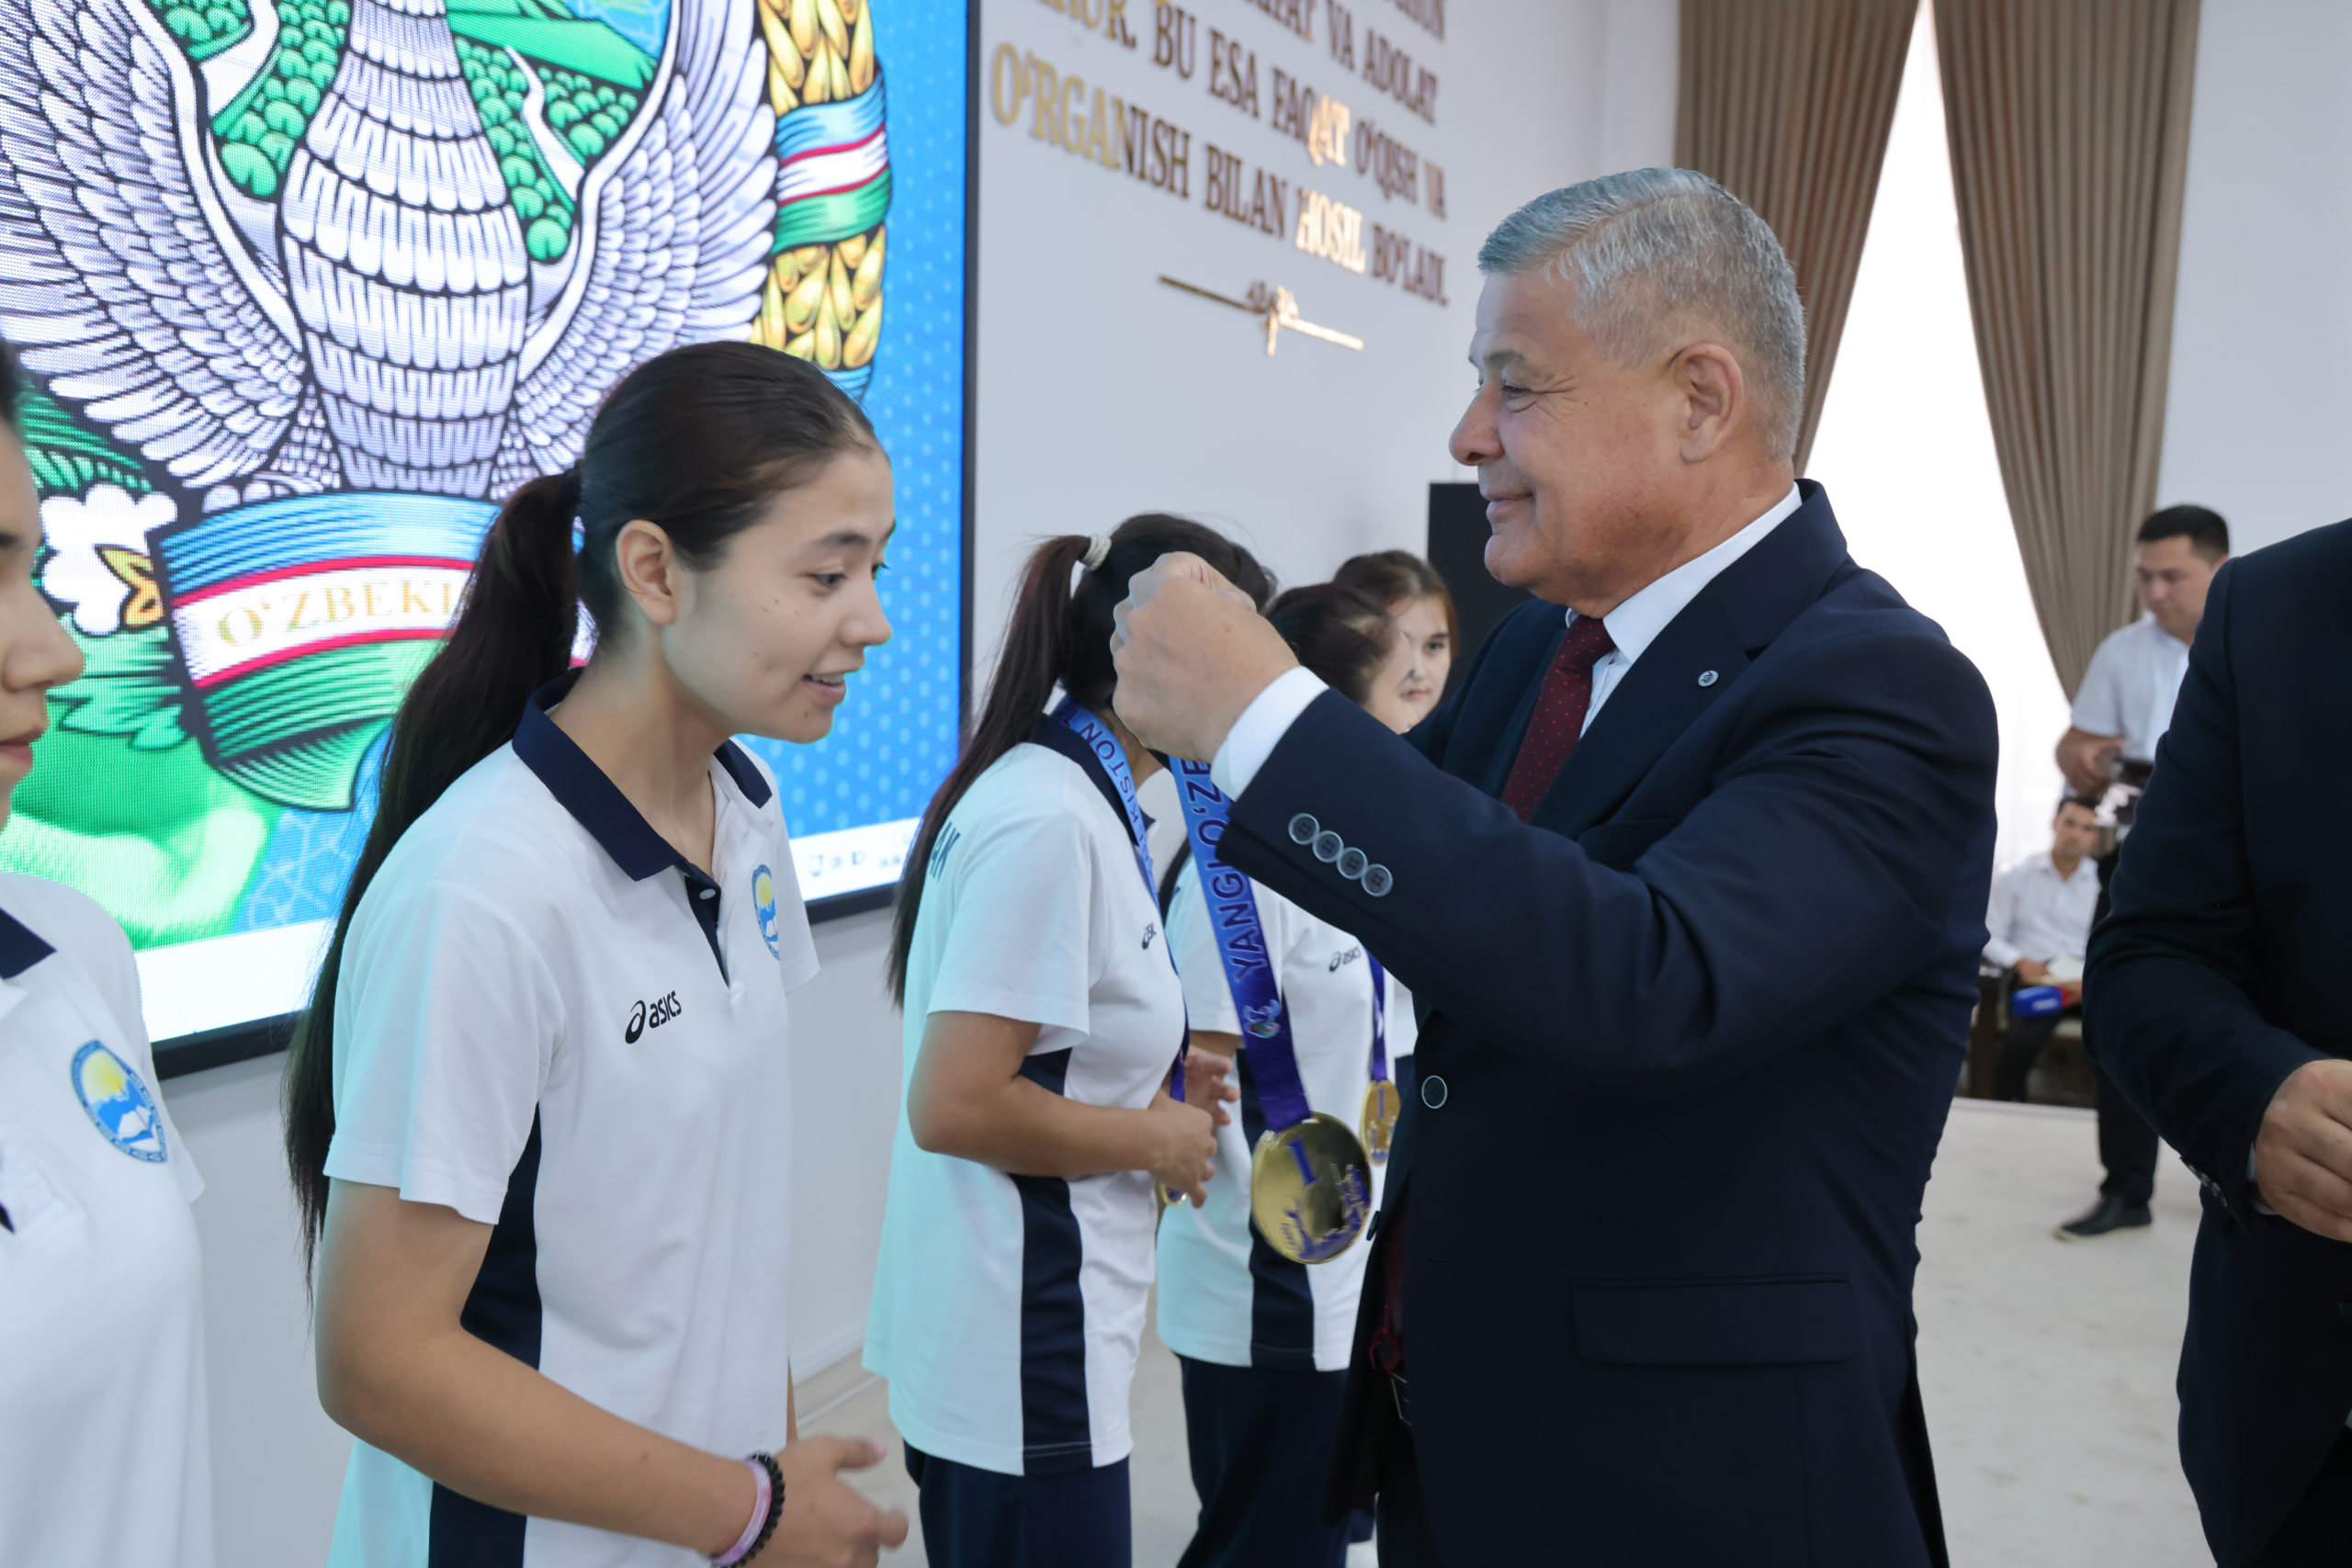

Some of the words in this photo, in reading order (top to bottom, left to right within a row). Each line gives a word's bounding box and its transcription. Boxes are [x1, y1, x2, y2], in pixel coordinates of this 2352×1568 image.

[1154, 0, 1197, 80] BU
[1208, 27, 1260, 119] ESA
[1204, 143, 1287, 240] BILAN
[218, 581, 454, 647] O'ZBEKI
[649, 990, 683, 1030] asics
